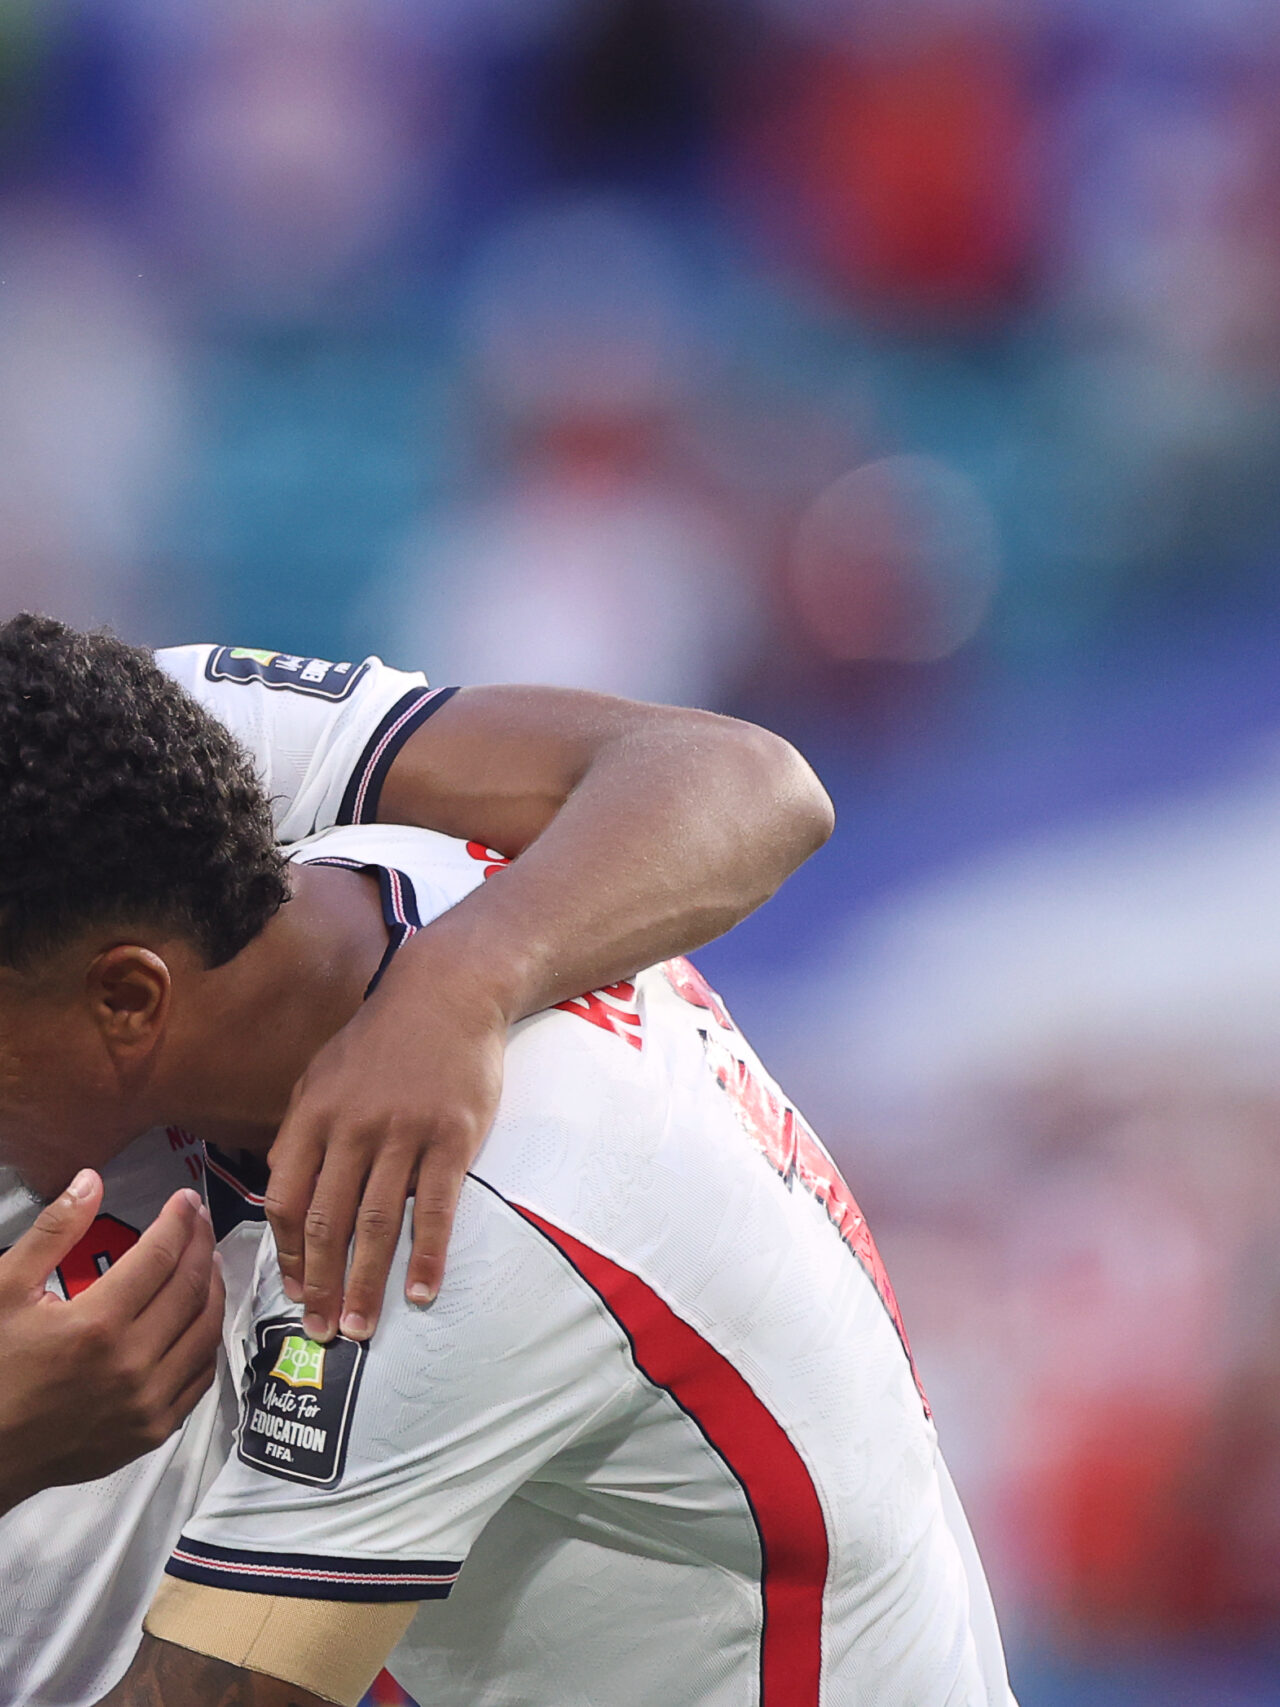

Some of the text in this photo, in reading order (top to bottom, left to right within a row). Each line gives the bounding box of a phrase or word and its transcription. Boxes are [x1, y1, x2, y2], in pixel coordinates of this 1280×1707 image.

[262, 1382, 321, 1419] Unite For
[250, 1407, 328, 1454] EDUCATION
[264, 1441, 293, 1462] FIFA
